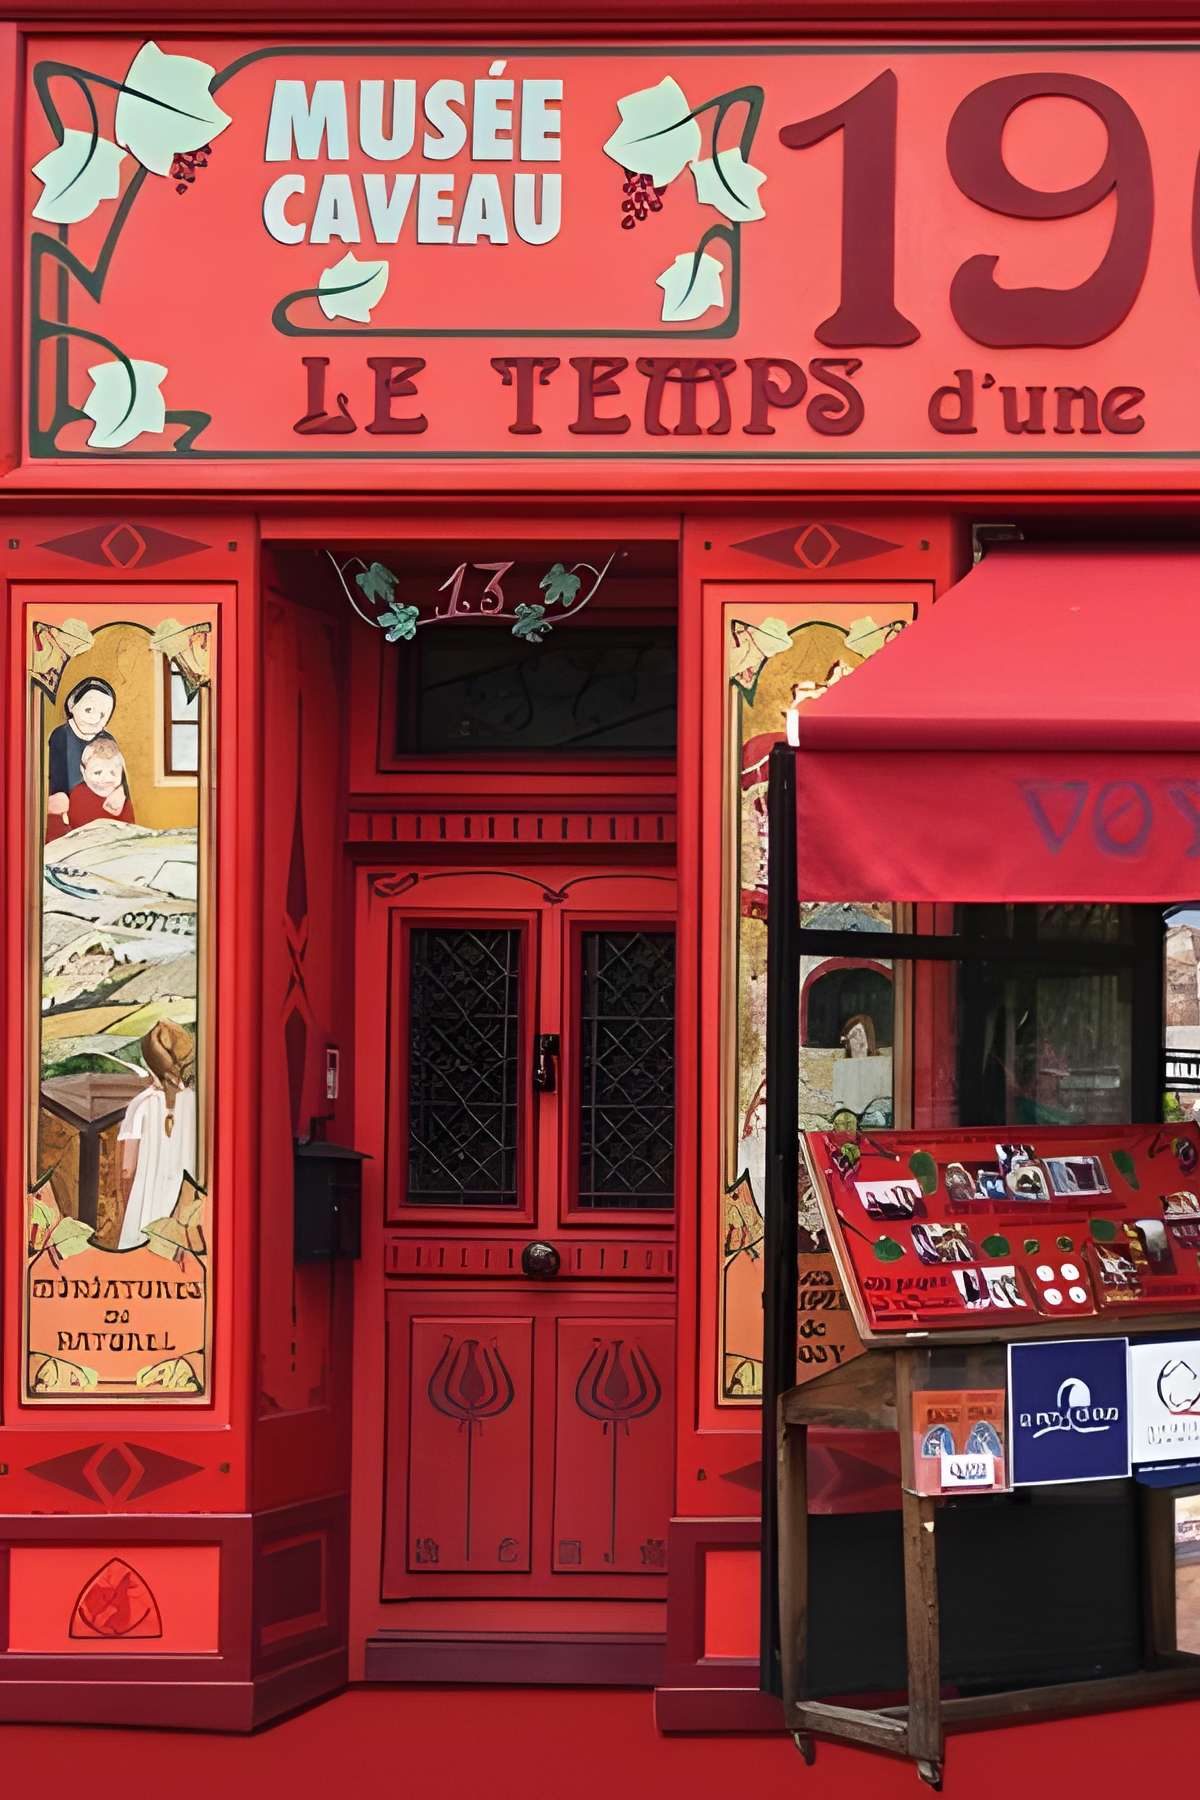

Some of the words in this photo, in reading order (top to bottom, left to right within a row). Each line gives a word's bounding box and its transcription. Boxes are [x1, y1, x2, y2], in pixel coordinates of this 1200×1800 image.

[265, 59, 564, 163] MUSÉE
[263, 173, 562, 246] CAVEAU
[292, 356, 428, 435] LE
[490, 357, 865, 436] TEMPS
[928, 369, 1146, 435] d'une
[438, 561, 514, 617] 13
